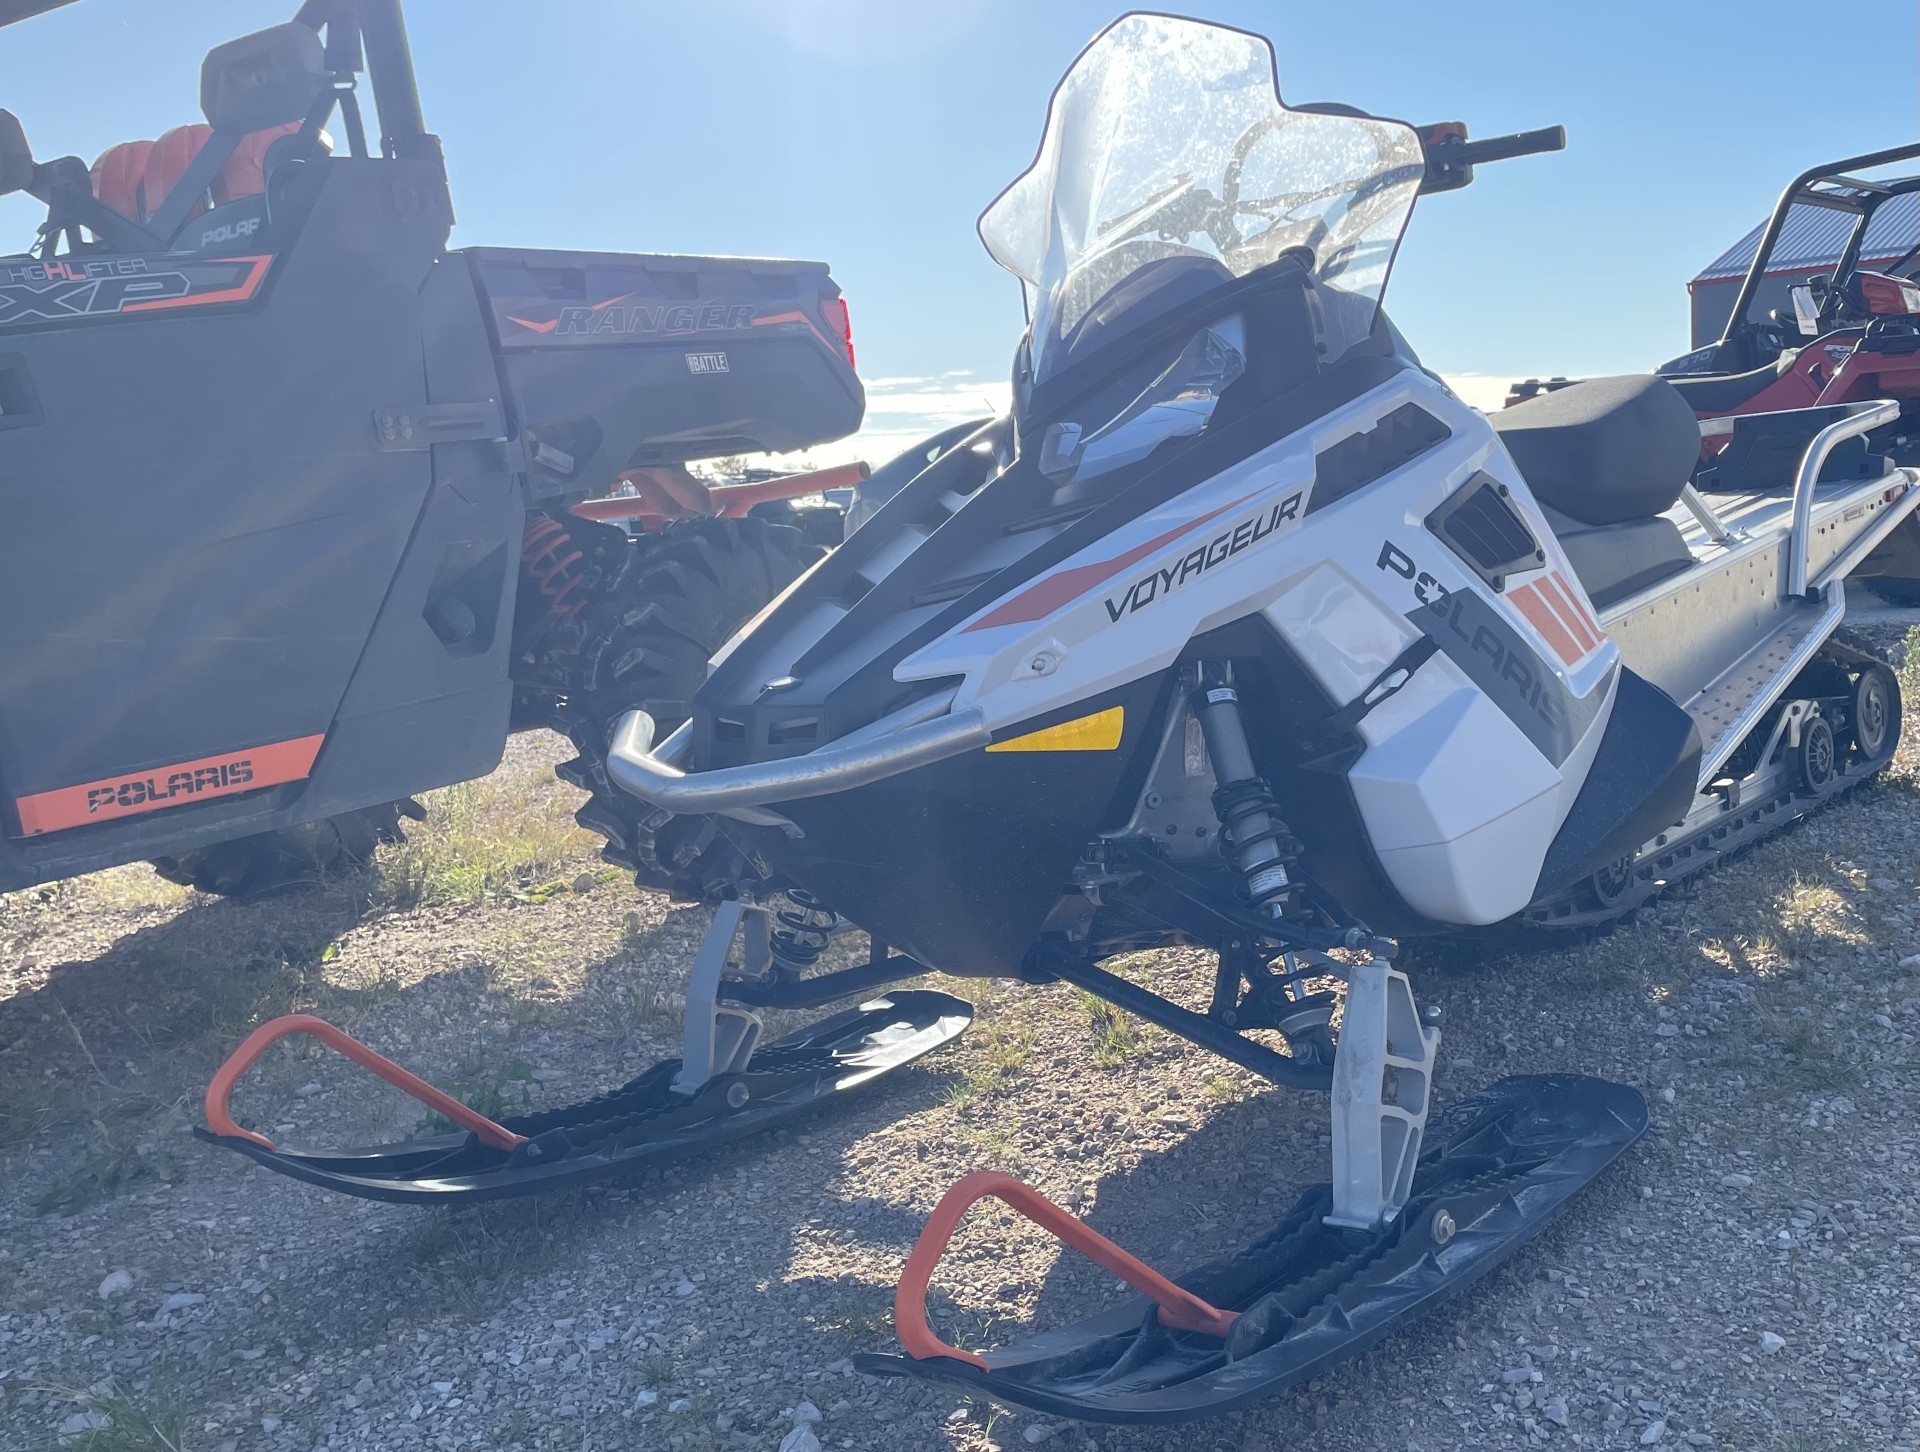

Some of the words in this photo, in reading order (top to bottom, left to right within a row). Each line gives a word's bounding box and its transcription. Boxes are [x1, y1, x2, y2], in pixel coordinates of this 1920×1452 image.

[554, 304, 758, 336] RANGER
[692, 354, 727, 372] BATTLE
[1104, 491, 1303, 623] VOYAGEUR
[1376, 539, 1565, 734] POLARIS
[87, 760, 254, 813] POLARIS
